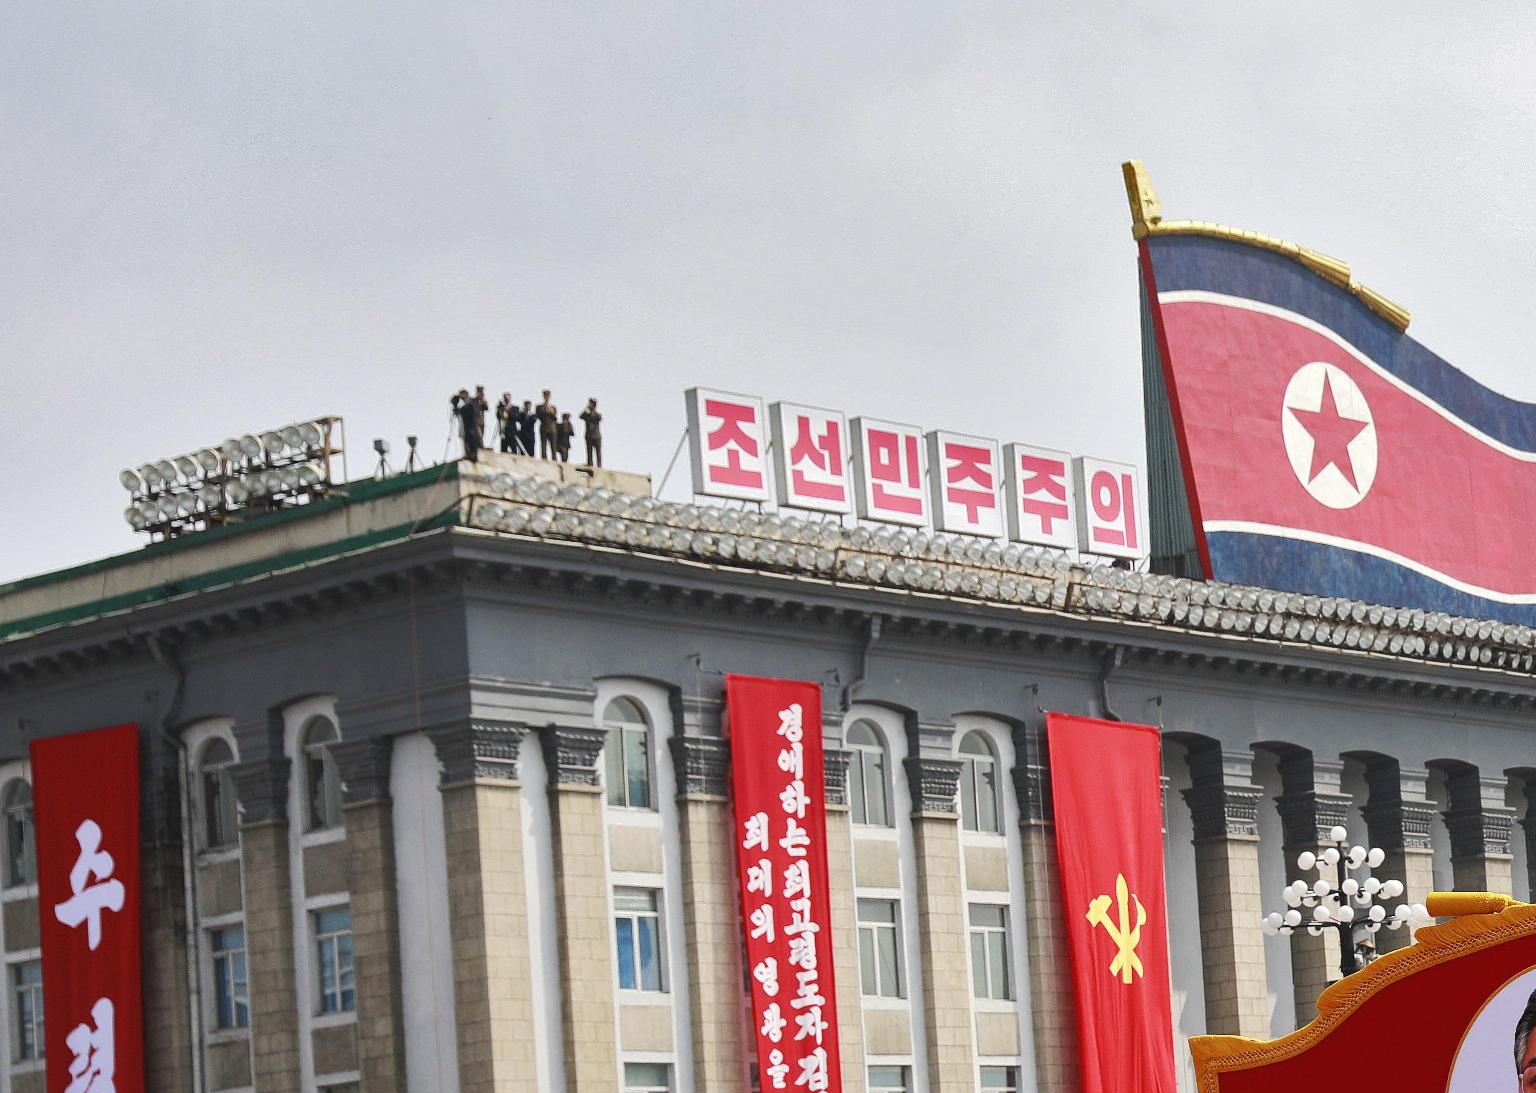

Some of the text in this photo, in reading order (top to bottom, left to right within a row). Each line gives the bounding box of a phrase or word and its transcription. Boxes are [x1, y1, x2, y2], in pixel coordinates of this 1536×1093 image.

[705, 398, 1137, 548] 조선민주주의
[777, 703, 811, 857] 경애하는
[743, 812, 775, 944] 최대의
[783, 859, 829, 1045] 최고령도자
[753, 957, 790, 1089] 영광을
